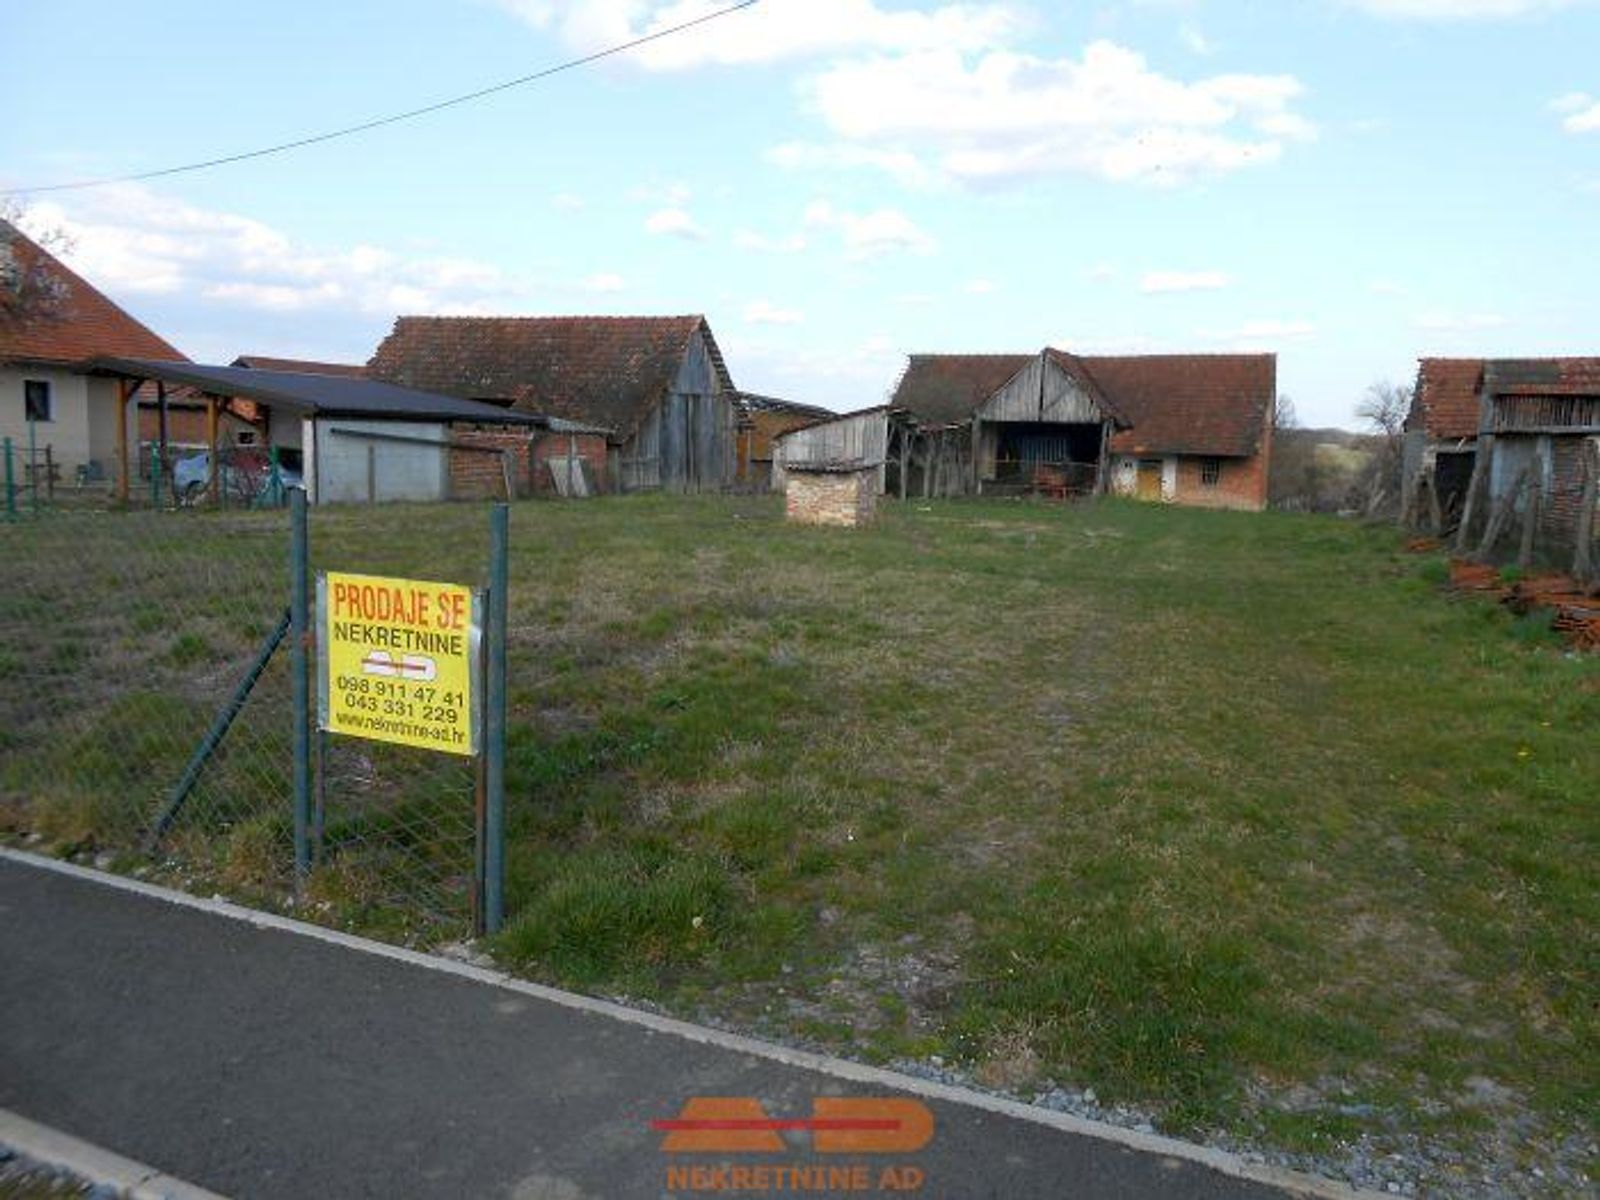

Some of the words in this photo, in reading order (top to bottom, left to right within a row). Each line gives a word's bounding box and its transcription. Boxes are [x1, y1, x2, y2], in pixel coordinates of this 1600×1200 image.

[334, 582, 429, 626] PRODAJE
[437, 592, 465, 630] SE
[334, 622, 462, 656] NEKRETNINE
[337, 676, 370, 694] 098
[375, 681, 406, 698] 911
[414, 687, 436, 703] 47
[443, 691, 464, 708] 41
[345, 693, 378, 712] 043
[384, 699, 413, 716] 331
[423, 705, 458, 724] 229
